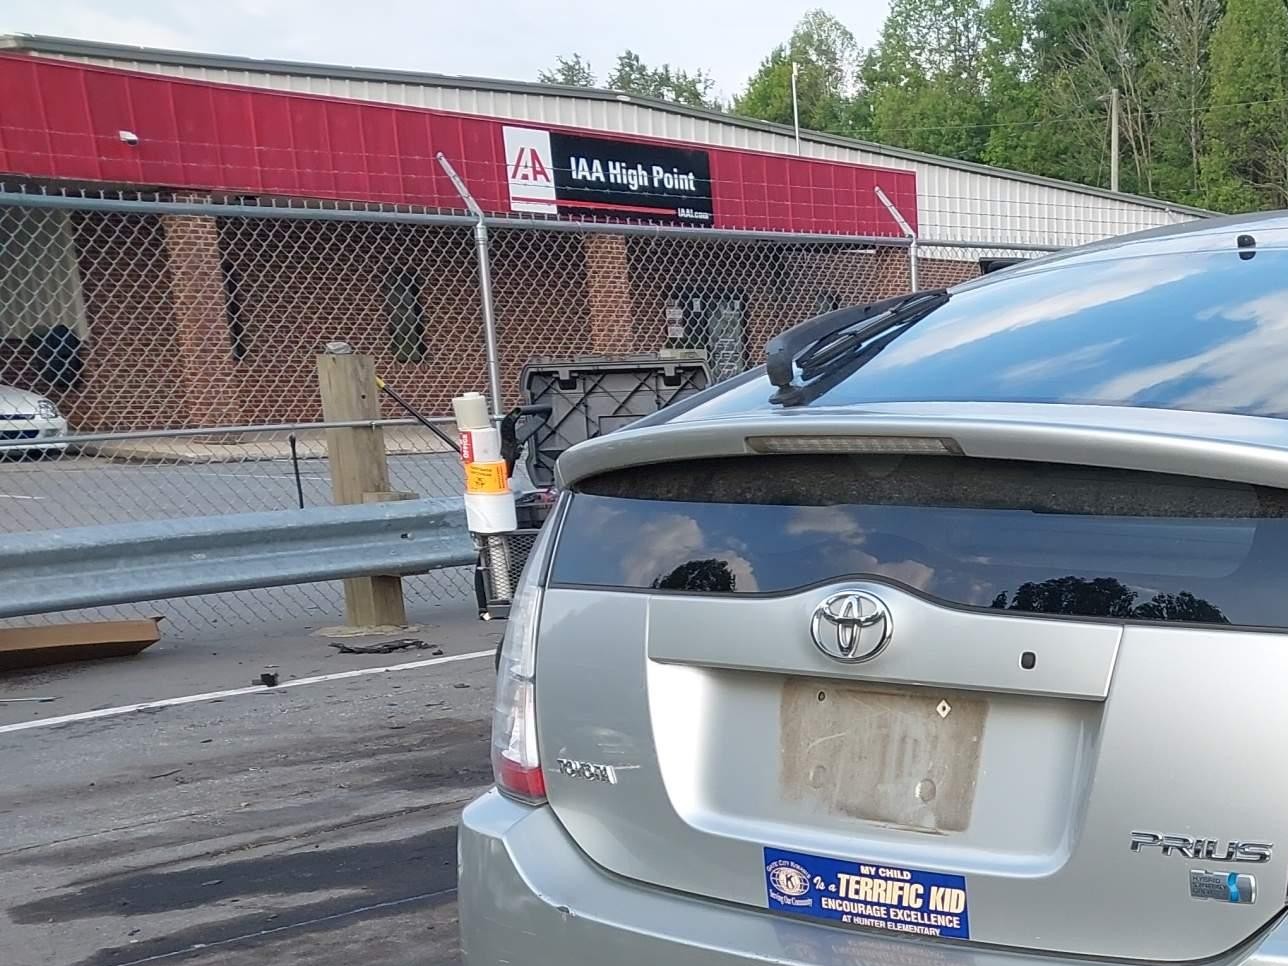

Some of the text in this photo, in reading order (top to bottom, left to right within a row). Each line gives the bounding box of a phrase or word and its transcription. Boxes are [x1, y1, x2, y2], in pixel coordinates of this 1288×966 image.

[570, 156, 696, 191] IAA High Point
[1130, 830, 1274, 863] PRIUS
[860, 865, 911, 880] MY CHILD
[828, 884, 838, 892] a
[837, 873, 924, 909] TERRIFIC
[929, 886, 965, 914] KID
[821, 897, 888, 918] ENCOURAGE
[890, 908, 961, 929] EXCELLENCE
[841, 915, 941, 936] AT HUNTER ELEMENTARY
